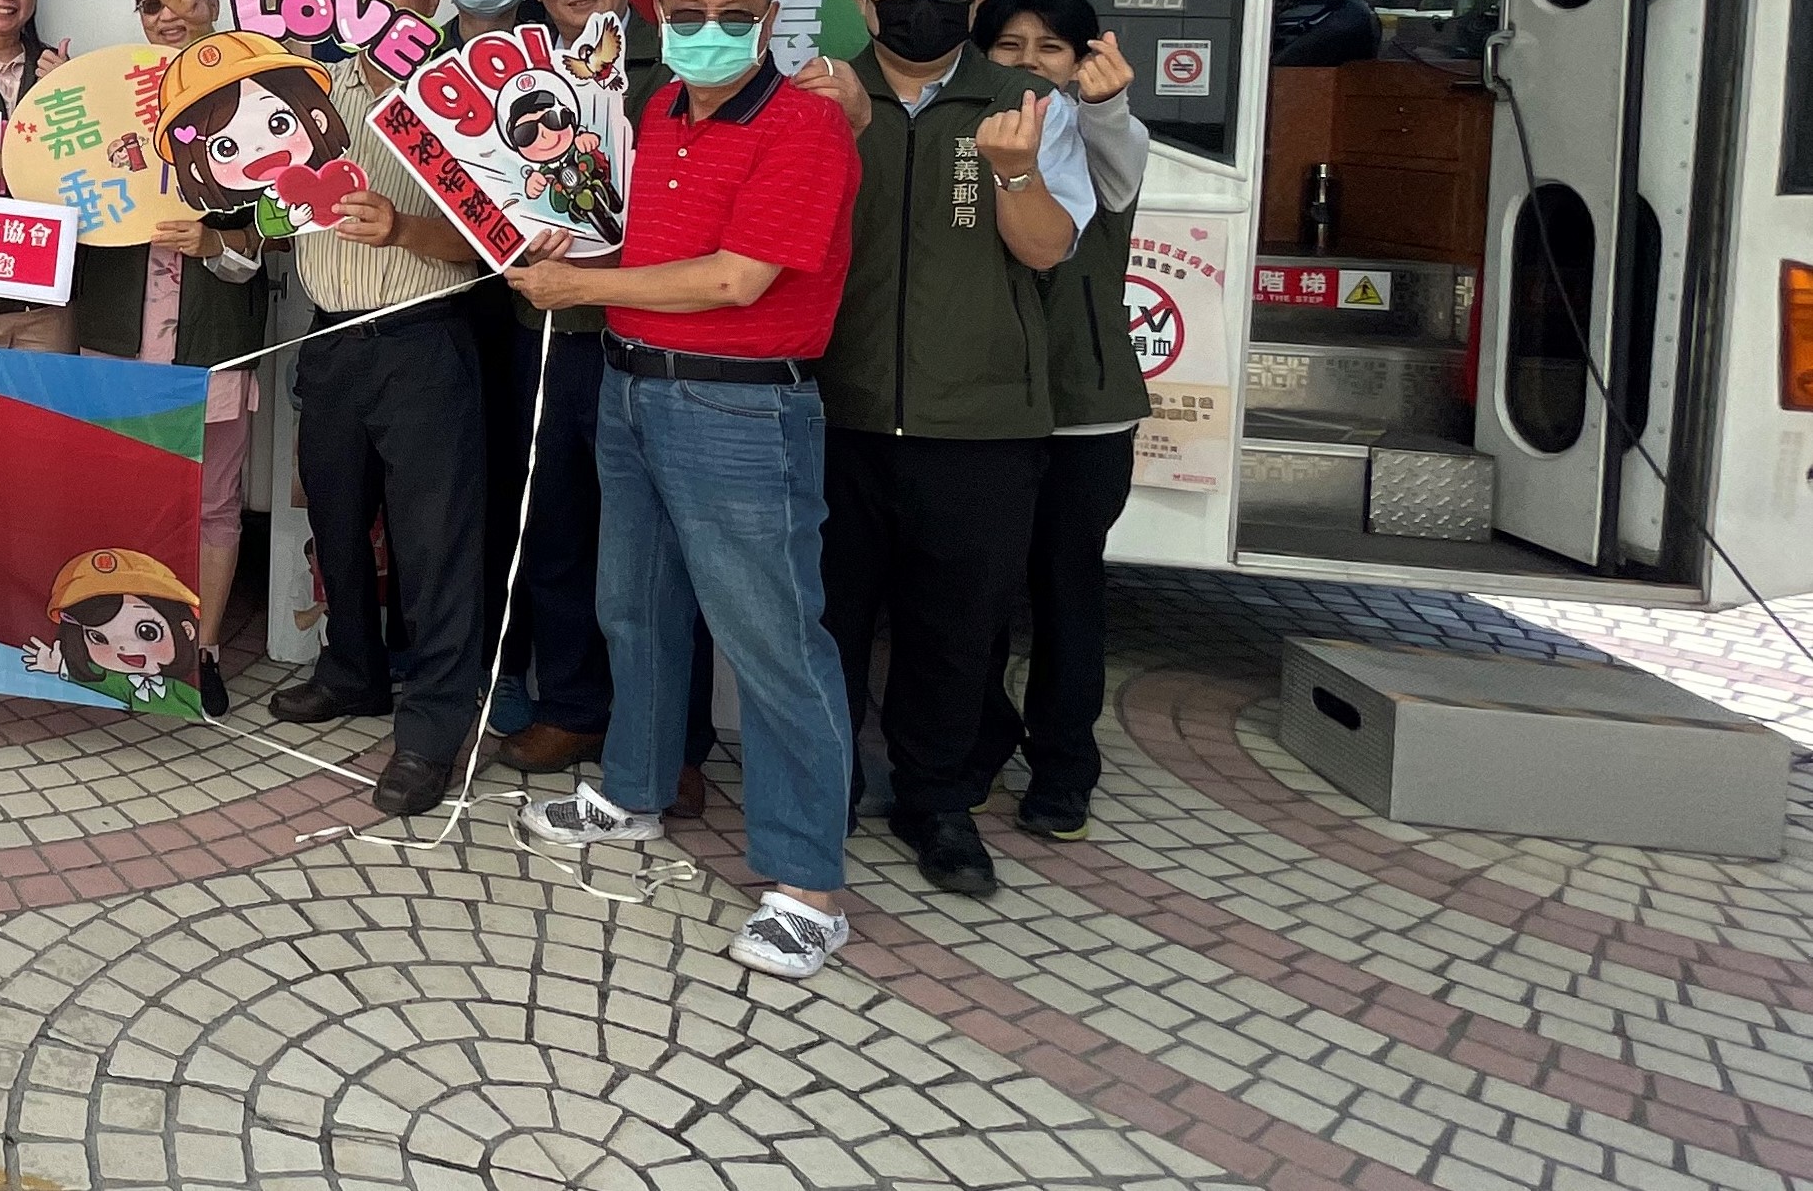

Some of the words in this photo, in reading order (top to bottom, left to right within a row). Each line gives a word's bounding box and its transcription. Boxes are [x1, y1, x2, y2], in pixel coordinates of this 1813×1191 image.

[950, 137, 979, 228] 嘉義郵局
[1258, 270, 1326, 294] 階梯
